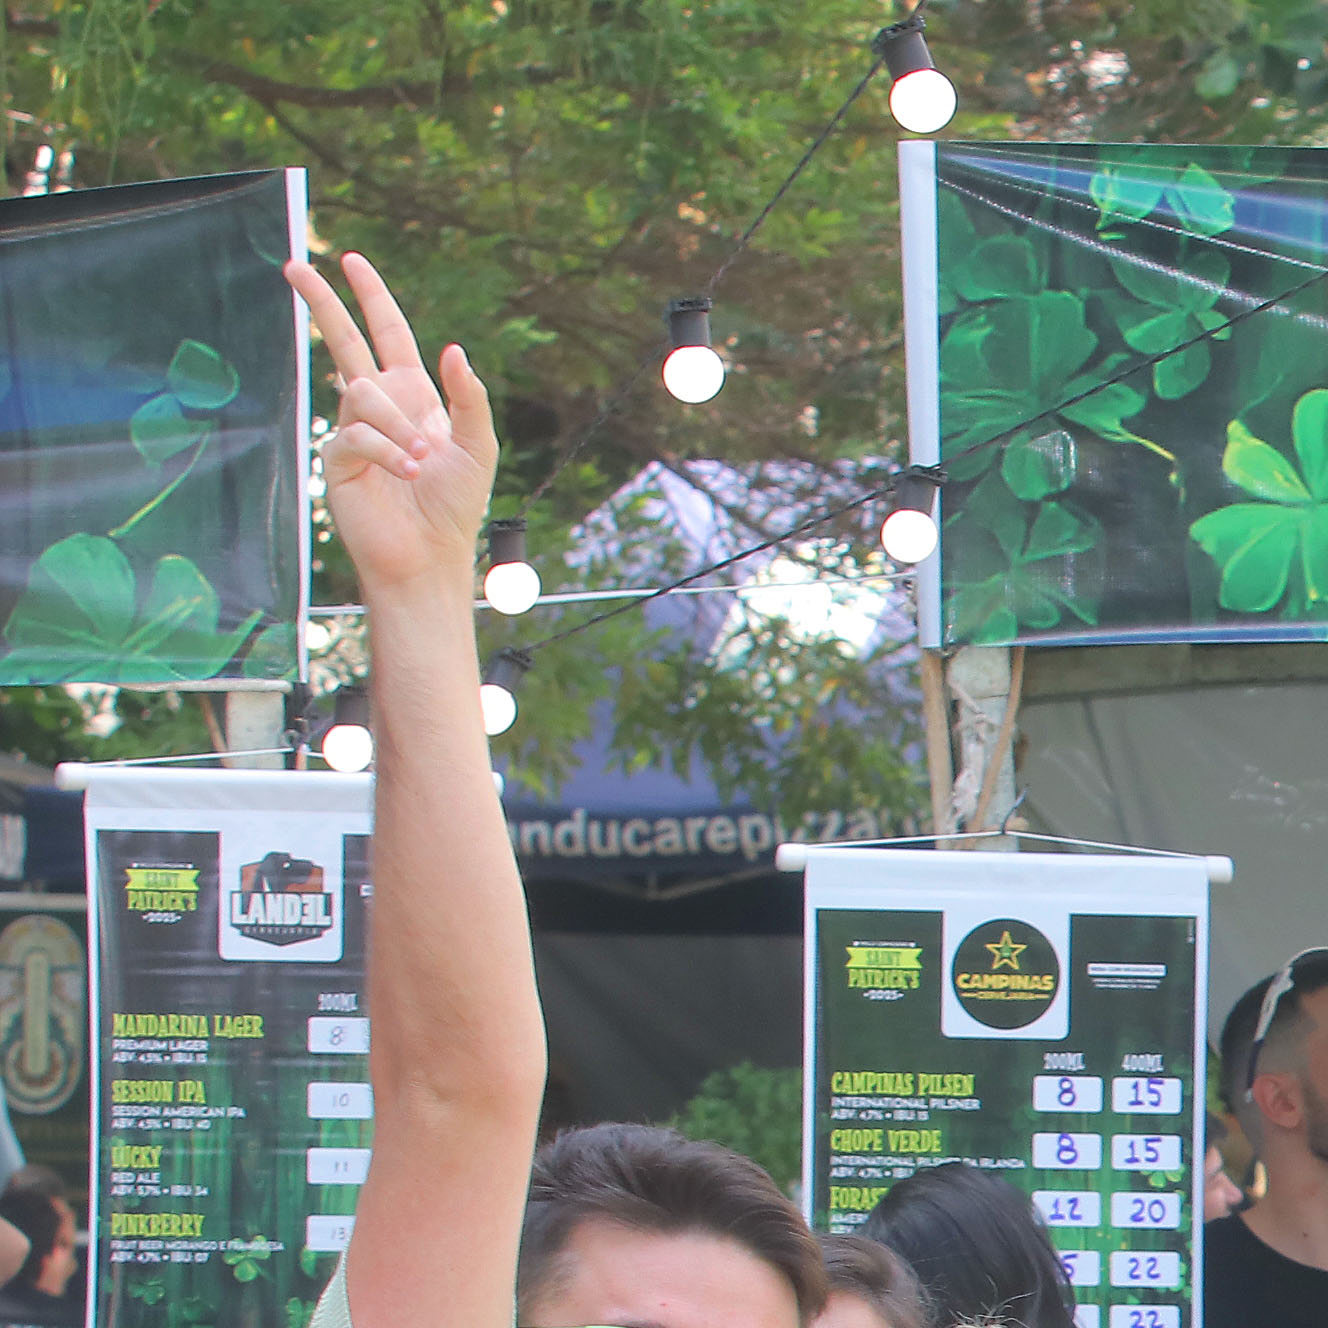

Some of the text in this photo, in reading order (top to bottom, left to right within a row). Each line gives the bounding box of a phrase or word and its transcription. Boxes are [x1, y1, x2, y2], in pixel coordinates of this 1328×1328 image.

[127, 890, 197, 911] PATRICK'S
[847, 968, 921, 989] PATRICK'S
[956, 972, 1055, 990] CAMPINAS
[112, 1013, 265, 1039] MANDARINA LAGER
[330, 1025, 344, 1046] 8
[112, 1038, 208, 1051] PREMIUM LAGER
[112, 1080, 207, 1104] SESSION IPA
[831, 1071, 976, 1097] CAMPINAS PILSEN
[1057, 1076, 1077, 1107] 8
[1127, 1077, 1165, 1108] 15
[111, 1105, 247, 1118] SESSION AMERICAN IPA
[830, 1096, 982, 1110] INTERNATIONAL PILSNER
[830, 1128, 943, 1153] CHOPE VERDE
[1057, 1132, 1078, 1165] 8
[1124, 1137, 1162, 1164] 15
[111, 1171, 161, 1184] RED ALE
[1050, 1197, 1083, 1221] 12
[1130, 1198, 1166, 1223] 20
[111, 1213, 206, 1237] PINKBERRY
[138, 1240, 164, 1251] BEER
[1128, 1257, 1161, 1280] 22
